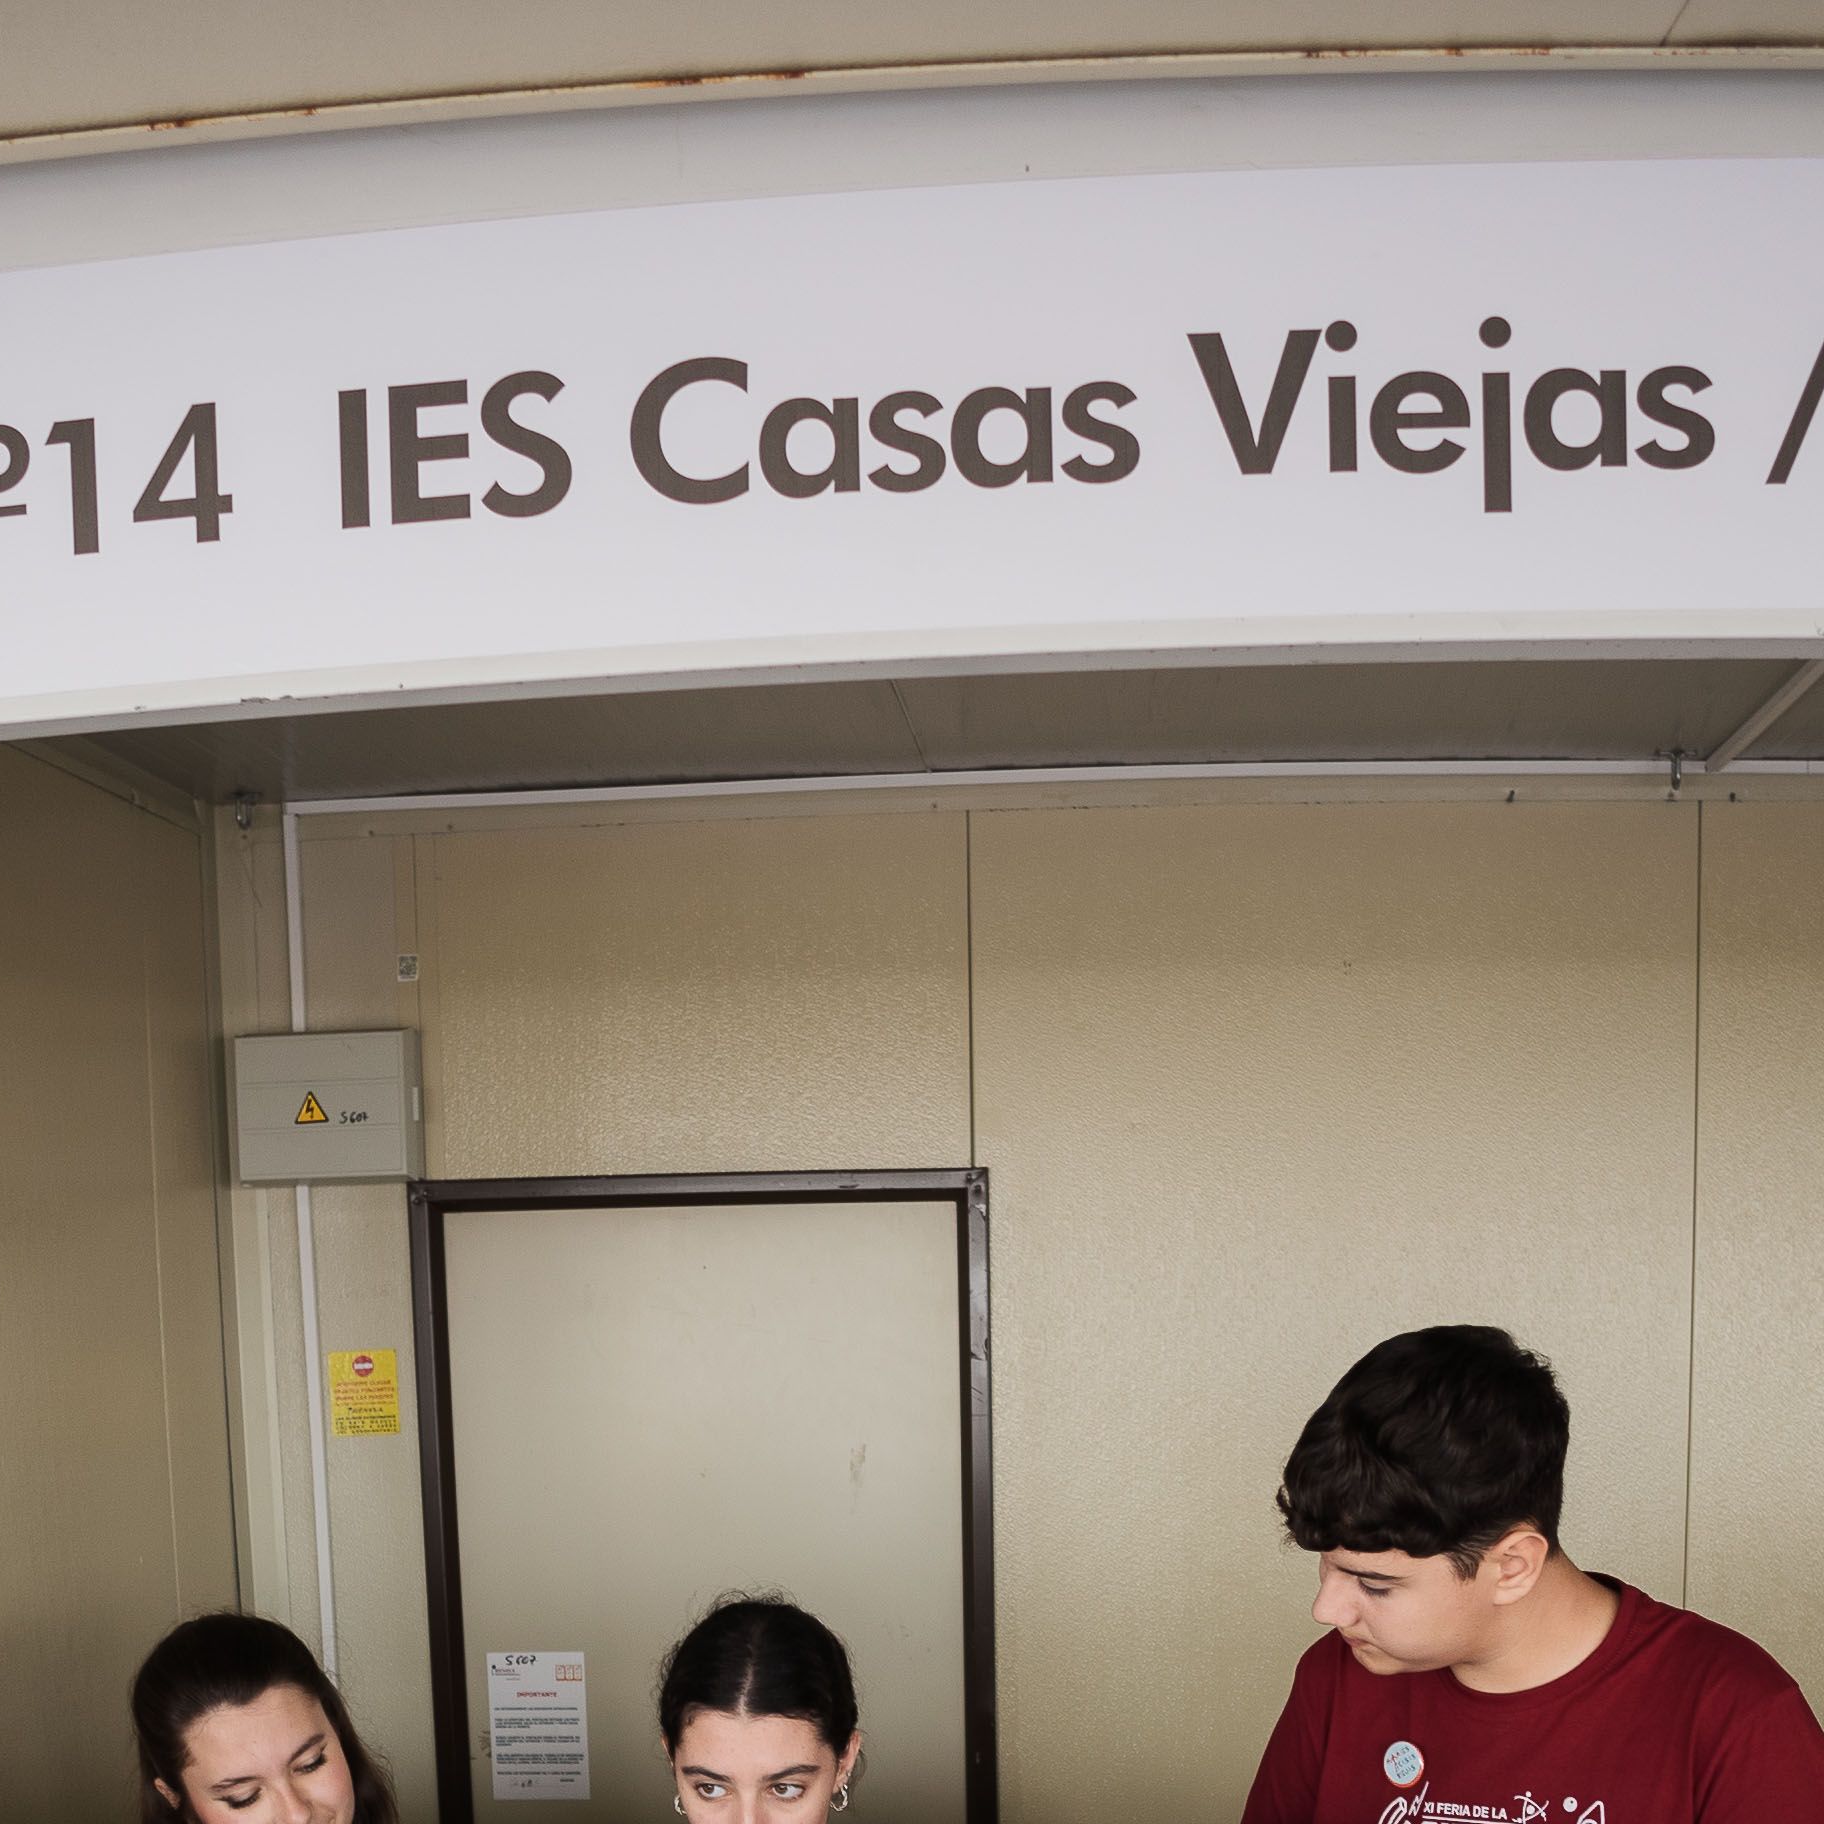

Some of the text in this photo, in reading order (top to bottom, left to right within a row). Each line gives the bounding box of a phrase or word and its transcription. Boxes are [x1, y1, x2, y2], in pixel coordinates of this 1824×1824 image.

[339, 371, 571, 528] IES
[631, 358, 1139, 503] Casas
[1188, 317, 1714, 512] Viejas
[1424, 1801, 1508, 1821] XI FERIA DE LA
